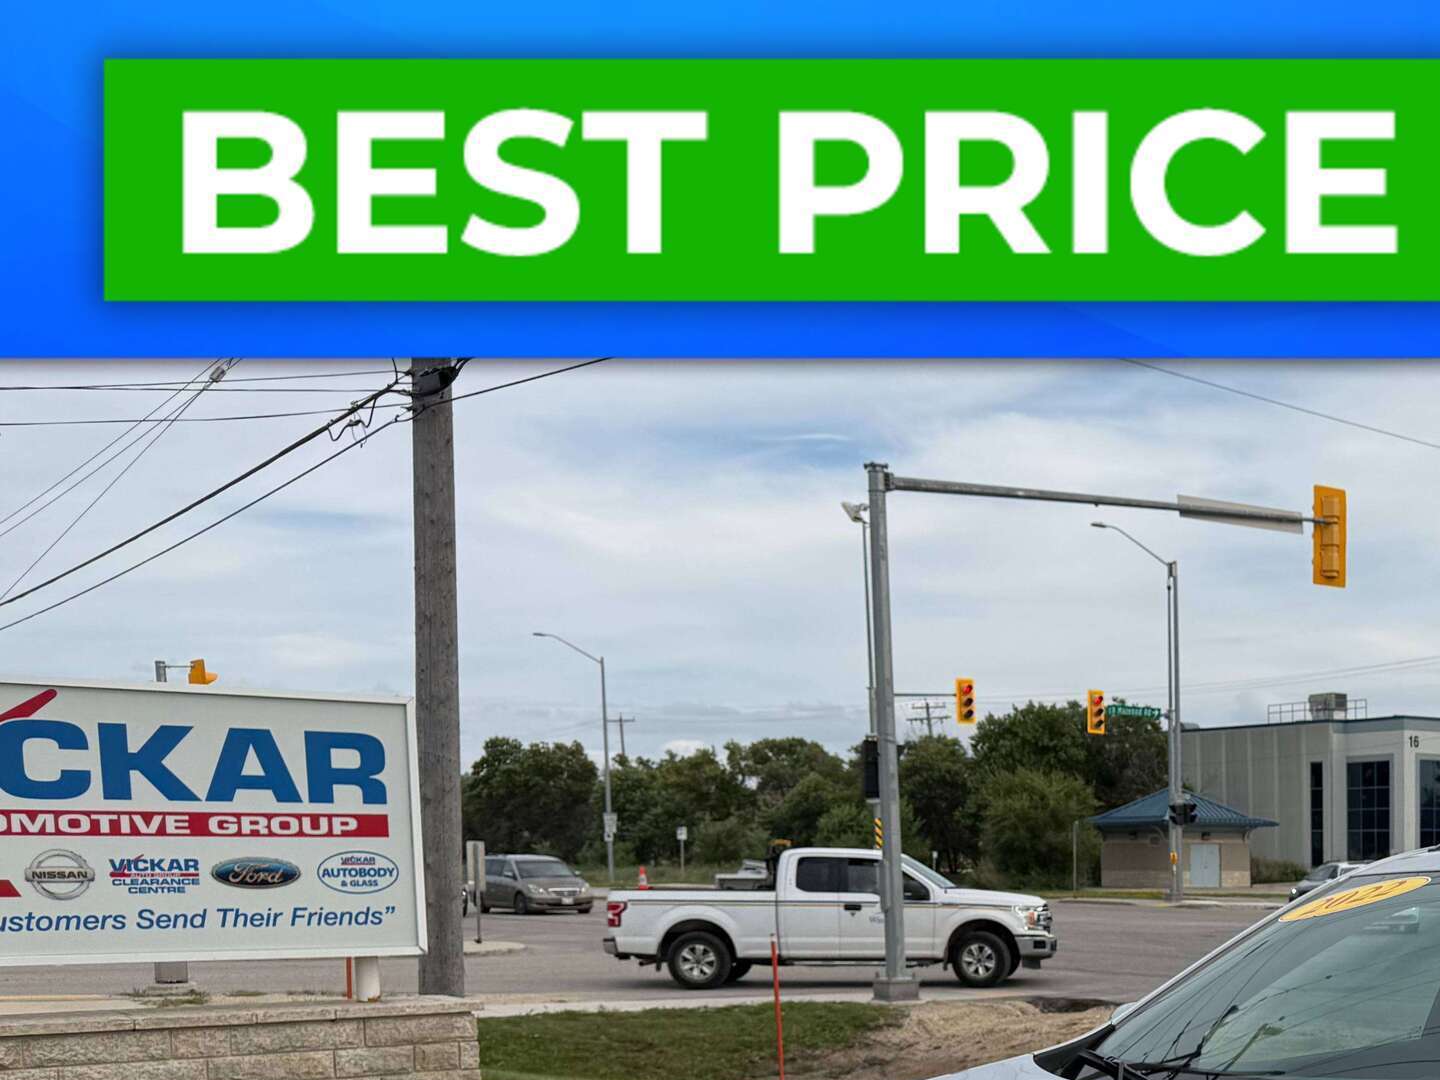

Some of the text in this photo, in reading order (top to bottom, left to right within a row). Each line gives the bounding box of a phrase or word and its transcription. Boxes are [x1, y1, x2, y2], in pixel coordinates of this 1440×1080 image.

[1409, 735, 1420, 748] 16
[208, 815, 359, 836] GROUP
[108, 858, 199, 872] VICKAR
[31, 870, 88, 880] NISSAN
[228, 862, 284, 884] Ford
[322, 867, 395, 878] AUTOBODY
[112, 878, 200, 886] CLEARANCE
[340, 879, 379, 887] & GLASS
[128, 886, 186, 894] CENTRE
[136, 908, 207, 931] Send
[216, 907, 283, 928] Their
